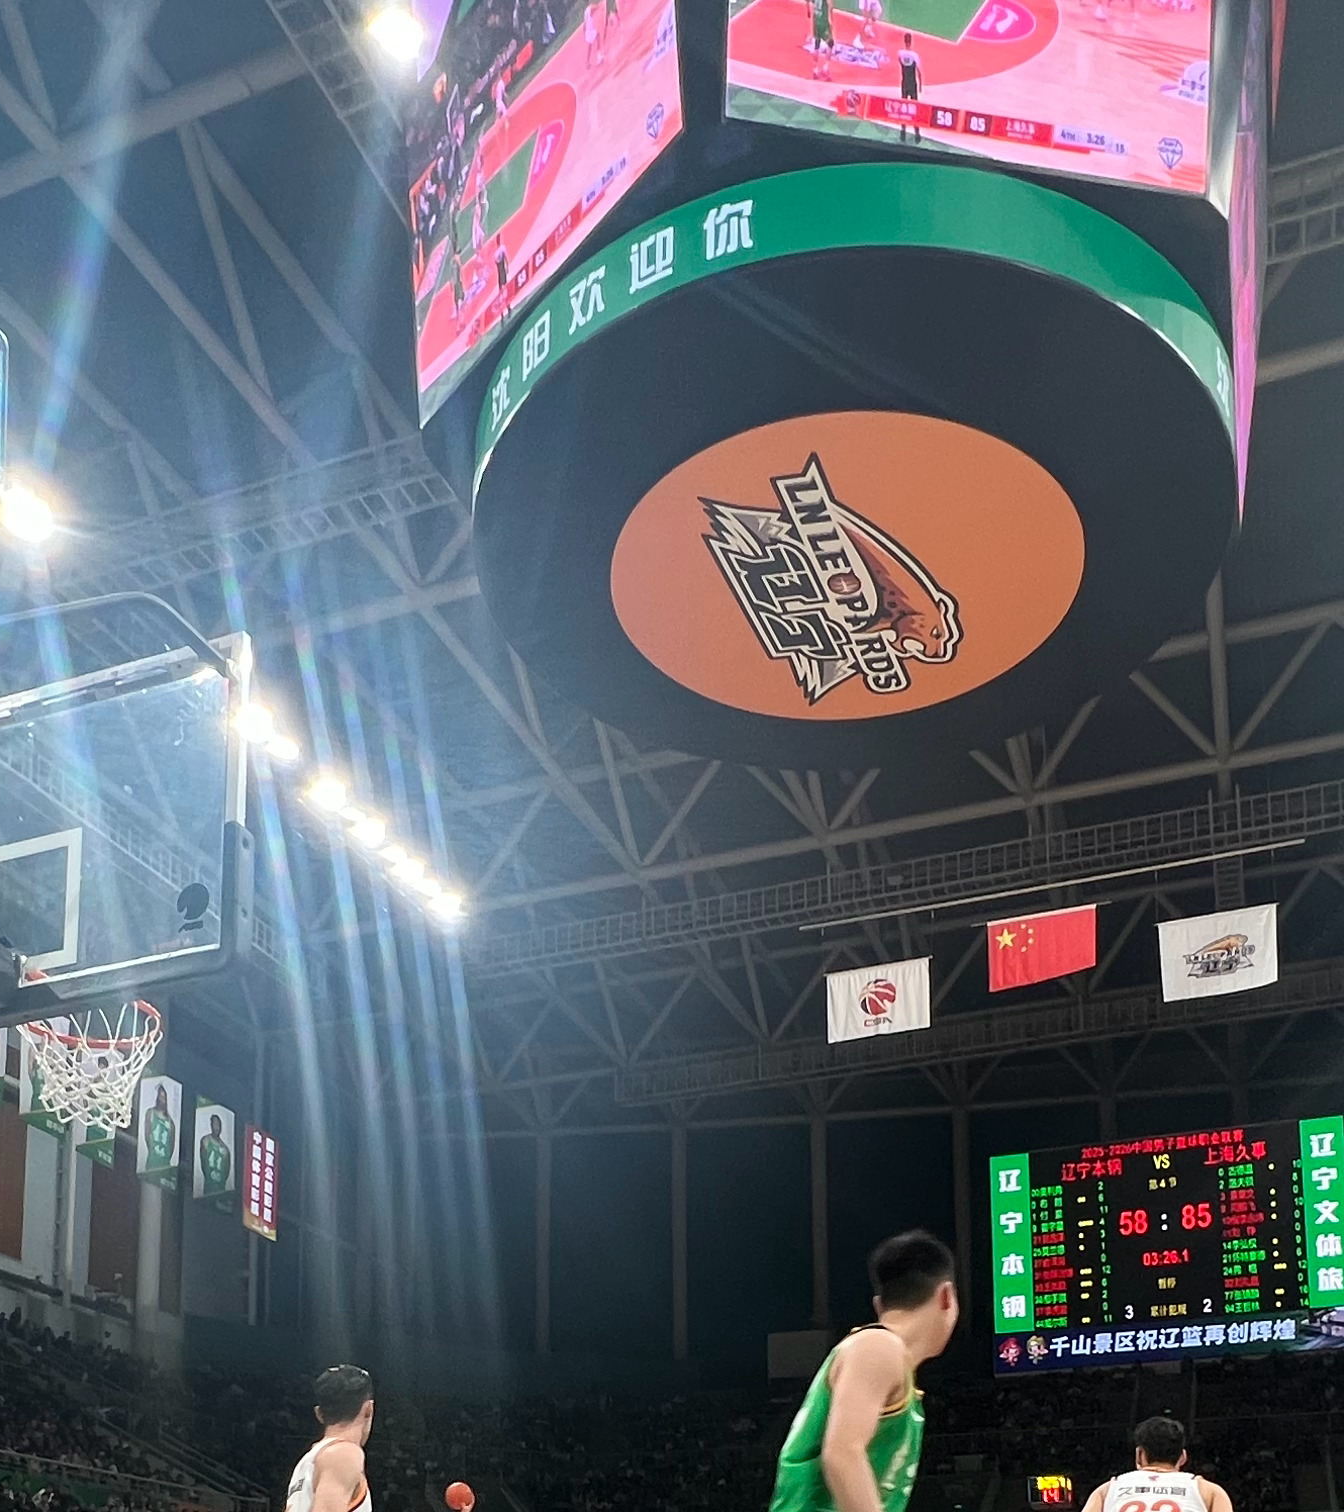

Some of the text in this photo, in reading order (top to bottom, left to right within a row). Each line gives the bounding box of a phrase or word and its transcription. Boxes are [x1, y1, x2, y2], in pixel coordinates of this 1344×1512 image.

[936, 110, 953, 127] 58
[969, 115, 986, 132] 85
[1061, 1158, 1123, 1182] 辽宁本钢
[1153, 1153, 1171, 1170] VS
[1119, 1209, 1149, 1236] 58
[1181, 1202, 1212, 1230] 85
[1309, 1132, 1344, 1292] 辽宁文体旅
[998, 1168, 1027, 1319] 辽宁本钢
[1142, 1248, 1189, 1266] 03:26.1
[1124, 1304, 1134, 1320] 3
[1202, 1298, 1213, 1313] 2
[1049, 1318, 1296, 1358] 千山景区祝辽篮再创辉煌
